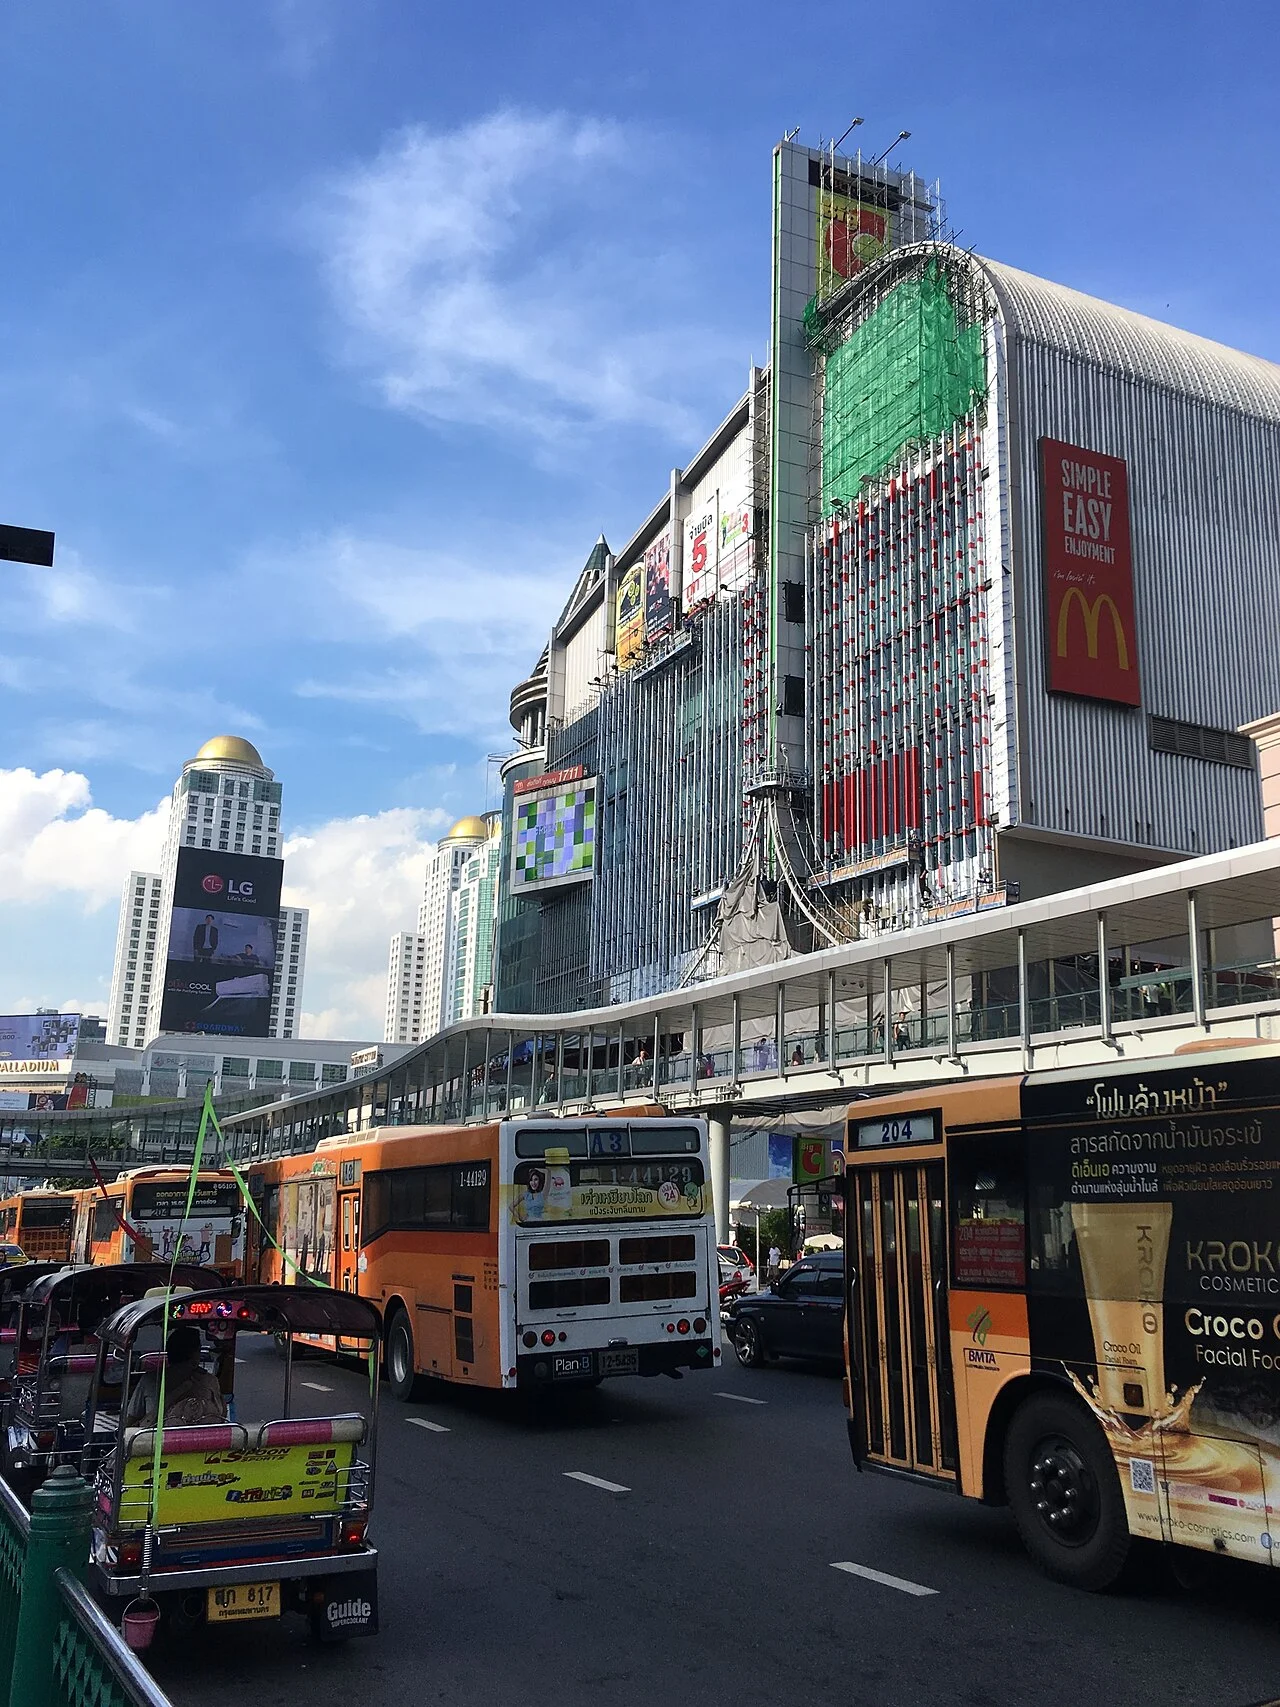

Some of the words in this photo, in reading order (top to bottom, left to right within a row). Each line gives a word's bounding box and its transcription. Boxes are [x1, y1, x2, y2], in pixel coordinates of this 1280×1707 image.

[1061, 459, 1112, 499] SIMPLE
[1063, 491, 1112, 541] EASY
[692, 531, 707, 573] 5
[1065, 536, 1115, 564] ENJOYMENT
[559, 767, 579, 781] 1711
[228, 880, 253, 895] LG
[881, 1120, 912, 1142] 204
[1071, 1119, 1262, 1154] สารสกัดจากน้ำมันจระเข้
[802, 1144, 823, 1175] C
[1072, 1159, 1110, 1178] ดีเอ็นเอ
[1112, 1163, 1157, 1175] ความงาม
[460, 1169, 487, 1188] 1-44129
[611, 1166, 691, 1185] 1-44129
[664, 1192, 676, 1201] 24
[1200, 1276, 1279, 1294] COSMETIC
[1185, 1307, 1264, 1340] Croco
[1103, 1340, 1128, 1353] Croco
[1196, 1345, 1247, 1367] Facial
[968, 1351, 996, 1365] BMTA
[247, 1586, 273, 1602] 817
[327, 1598, 371, 1621] Guide
